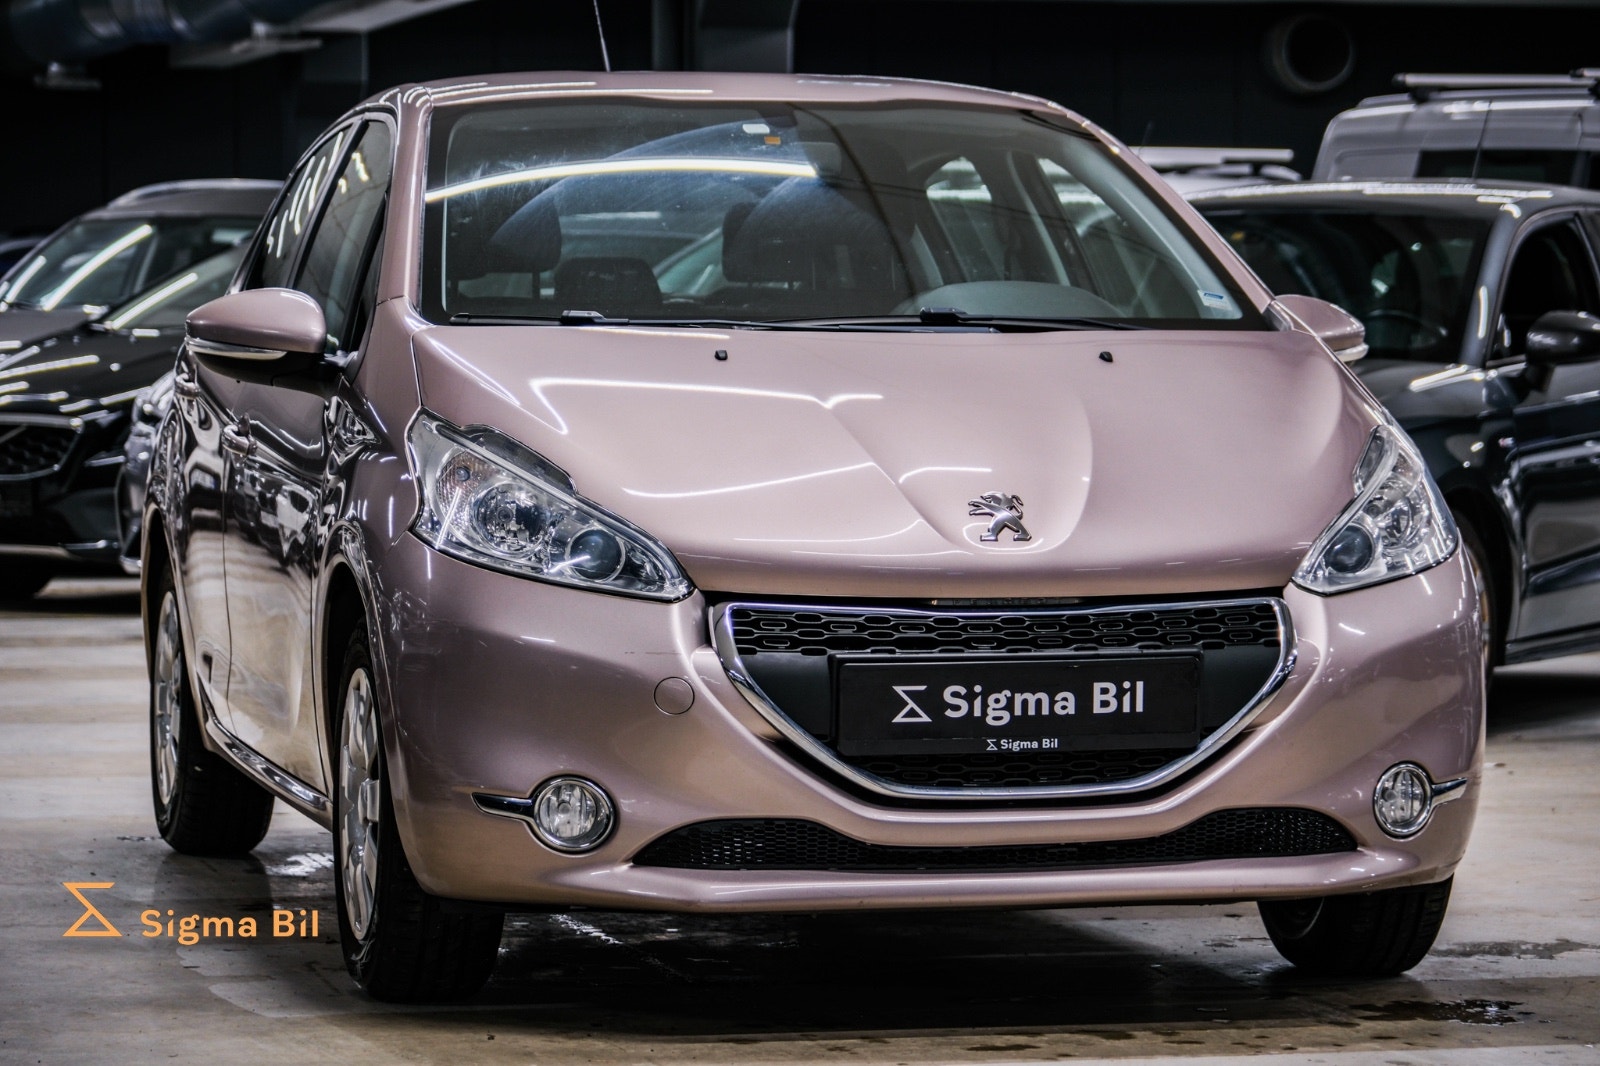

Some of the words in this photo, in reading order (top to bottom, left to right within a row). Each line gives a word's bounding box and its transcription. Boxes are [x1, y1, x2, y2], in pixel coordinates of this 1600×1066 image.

[942, 684, 1076, 727] Sigma
[1092, 680, 1144, 714] Bil
[1000, 738, 1039, 752] Sigma
[1042, 738, 1058, 749] Bil
